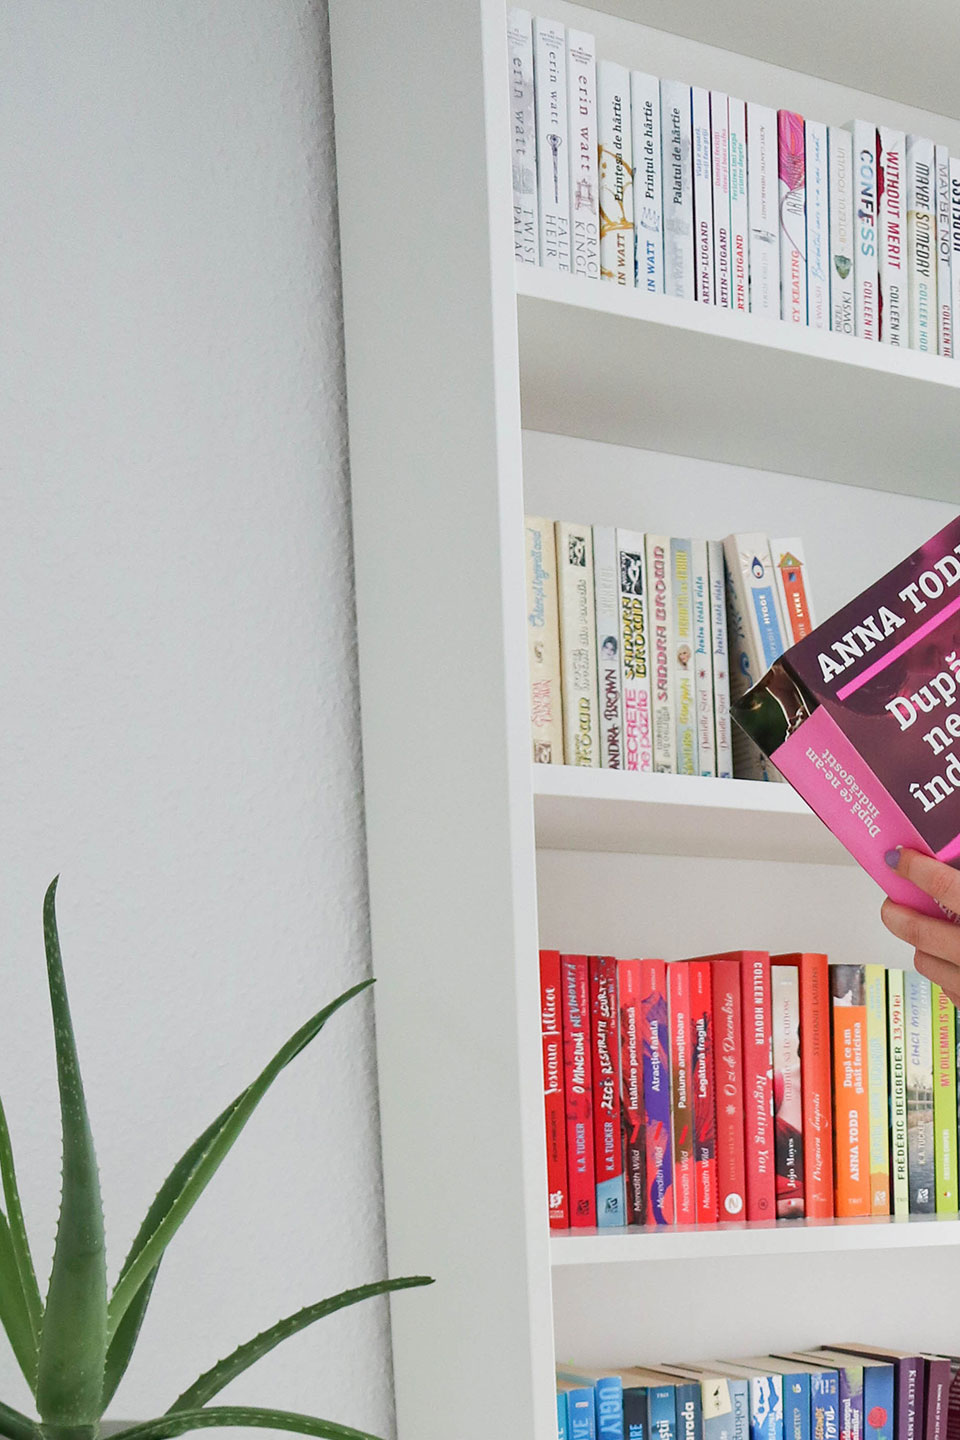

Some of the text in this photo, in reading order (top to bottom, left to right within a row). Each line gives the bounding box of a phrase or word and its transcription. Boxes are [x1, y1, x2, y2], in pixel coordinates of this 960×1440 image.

[578, 75, 590, 171] erin watt
[643, 101, 655, 200] Prințul de hârtie
[672, 107, 683, 205] Palatul de hârtie
[859, 150, 875, 257] CONFESS
[886, 151, 901, 269] WITHOUT MERIT
[915, 162, 930, 277] MAYBE SOMEDAY
[938, 164, 951, 266] MAYBE NOT
[545, 214, 557, 258] HEIR
[863, 281, 873, 325] COLLEEN
[889, 285, 899, 329] COLLEEN
[942, 304, 950, 345] COLLEEN
[652, 546, 666, 622] BROWN
[760, 594, 771, 624] HYGGE
[793, 592, 804, 618] LYKKE
[621, 596, 635, 680] SANDRA
[633, 598, 648, 679] BROWN
[653, 627, 669, 702] SANDRA
[817, 605, 906, 683] ANNA
[700, 689, 711, 750] Danielle Steel
[805, 747, 882, 838] După ce ne-am
[821, 749, 881, 821] îndrăgostit
[753, 962, 765, 1045] COLLEEN HOOVER
[939, 1010, 949, 1022] IS
[626, 1007, 639, 1110] Întâlnire periculoasă
[649, 1020, 661, 1092] Atracție fatală
[842, 1029, 853, 1087] După ce am
[852, 1022, 862, 1066] fericirea
[940, 1026, 951, 1070] DILEMMA
[677, 1070, 687, 1109] Pasiune
[893, 1046, 905, 1116] BEIGBEDER
[940, 1072, 950, 1087] MY
[754, 1074, 769, 1173] Regretting You
[848, 1110, 859, 1181] ANNA TODD
[892, 1120, 906, 1180] FRÉDÉRIC
[630, 1150, 642, 1212] Meredith Wild
[654, 1146, 665, 1209] Meredith Wild
[680, 1150, 691, 1212] Meredith Wild
[700, 1148, 711, 1209] Meredith Wild
[785, 1137, 797, 1188] Jojo Moyes
[600, 1386, 622, 1434] UGLY
[906, 1369, 917, 1408] KELLEY
